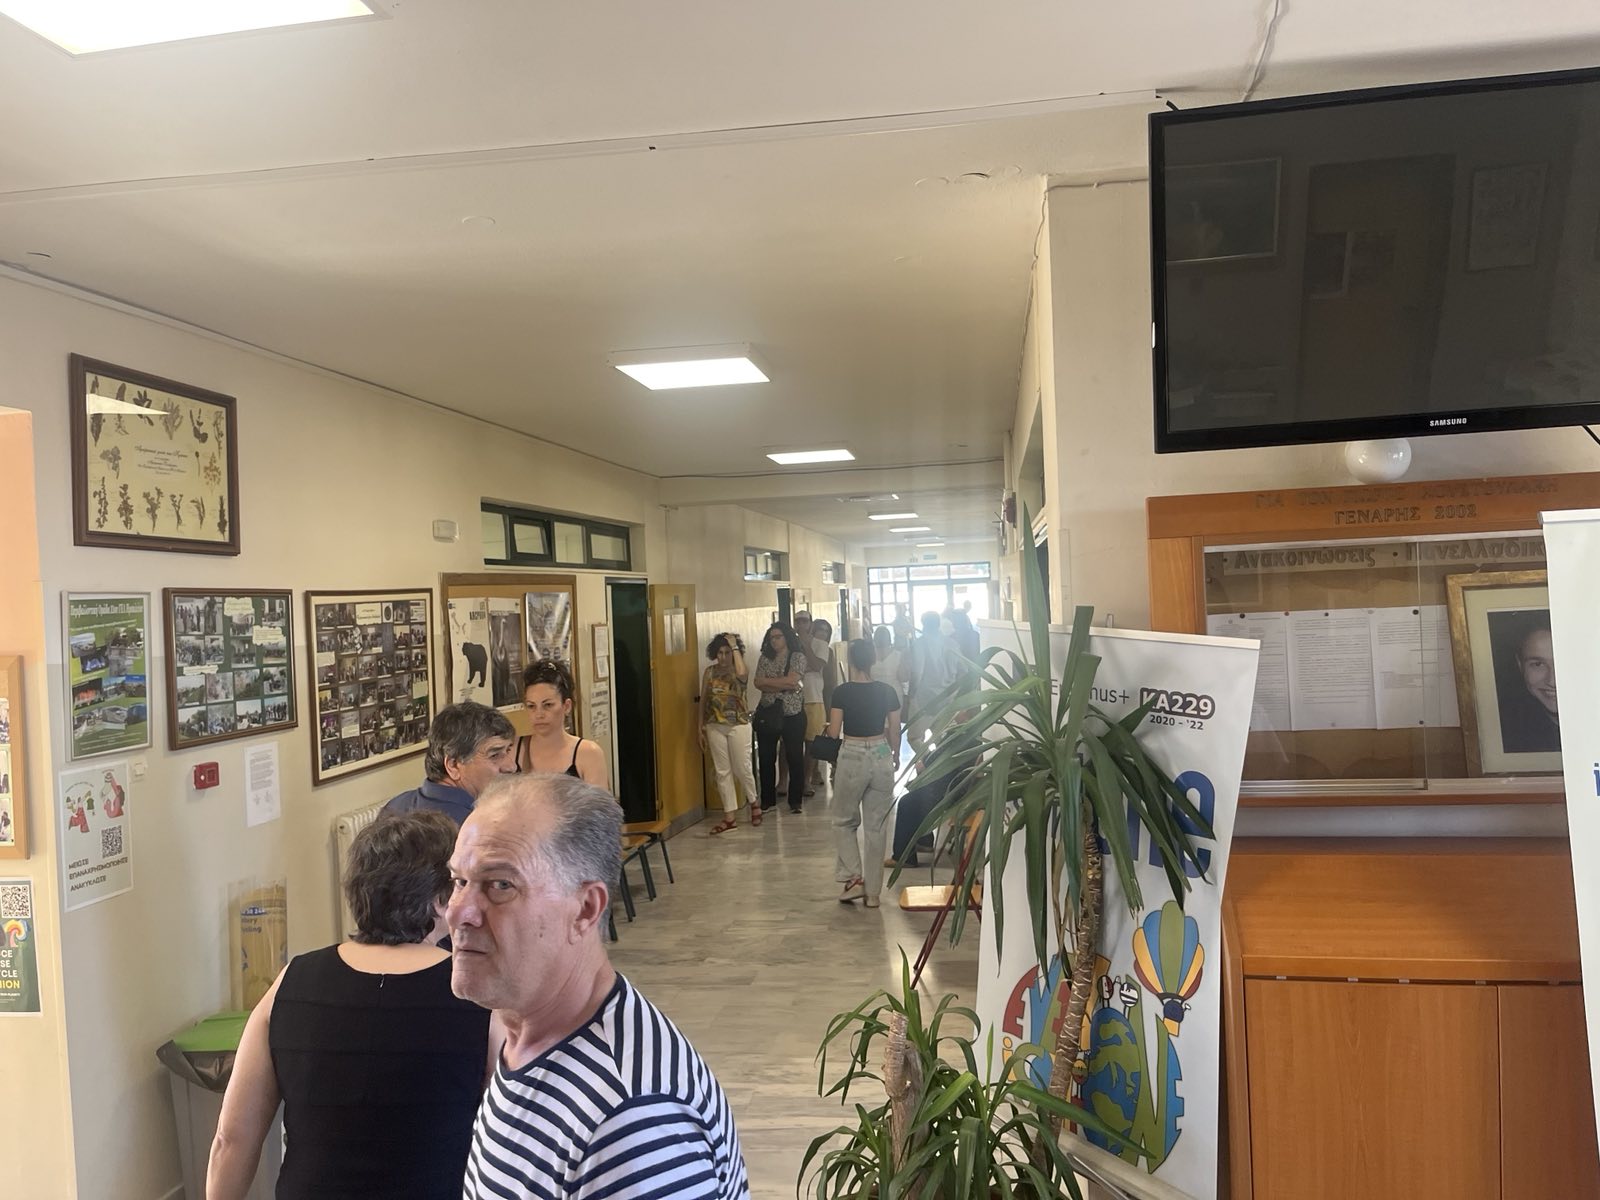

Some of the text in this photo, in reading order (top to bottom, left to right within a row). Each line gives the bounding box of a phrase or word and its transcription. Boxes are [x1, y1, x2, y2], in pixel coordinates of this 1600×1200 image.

[1429, 417, 1468, 427] SAMSUNG
[1334, 503, 1477, 525] ΓΕΝΑΡΗΣ 2002
[1149, 714, 1175, 727] 2020
